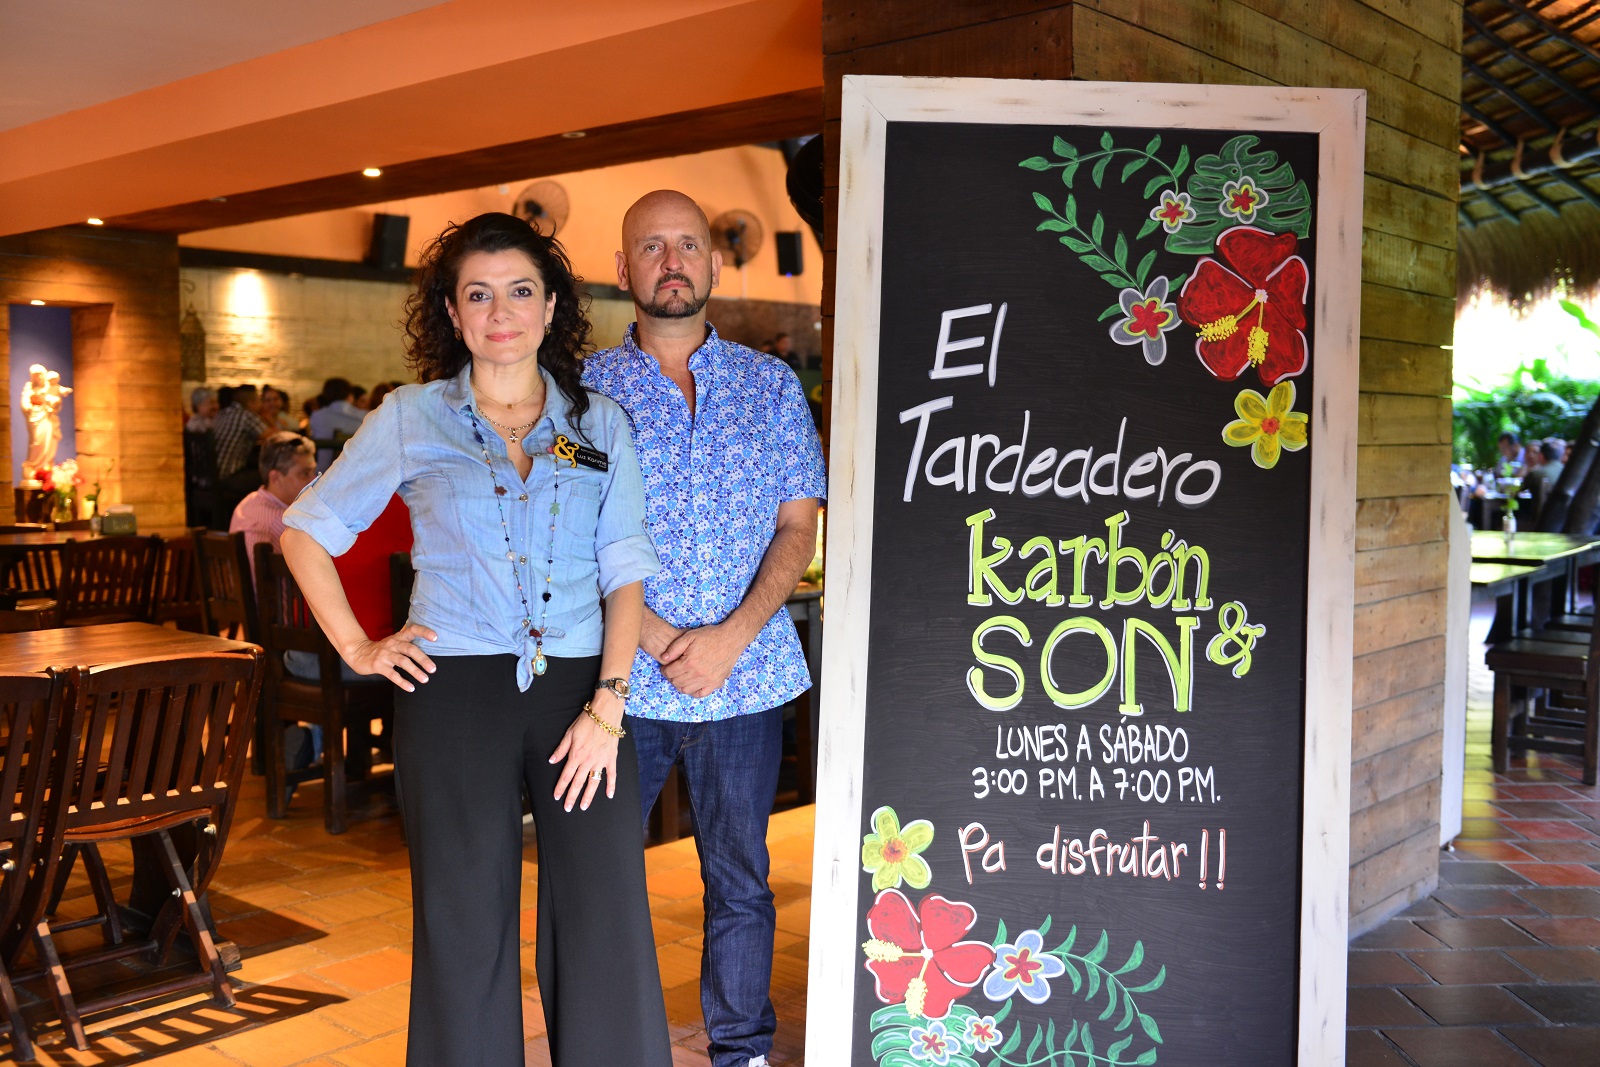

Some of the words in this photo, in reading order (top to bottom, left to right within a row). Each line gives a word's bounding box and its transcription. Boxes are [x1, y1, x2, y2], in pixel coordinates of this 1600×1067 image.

[929, 302, 1008, 387] El
[899, 396, 1221, 508] Tardeadero
[966, 615, 1200, 716] SON
[1206, 601, 1266, 678] &
[995, 724, 1069, 762] LUNES
[1076, 724, 1092, 762] A
[1099, 716, 1189, 764] SÁBADO
[971, 766, 1028, 799] 3:00
[1038, 767, 1082, 800] P.M.
[1089, 766, 1106, 801] A
[1114, 768, 1171, 803] 7:00
[1178, 767, 1221, 803] P.M.
[958, 821, 1007, 884] Pa
